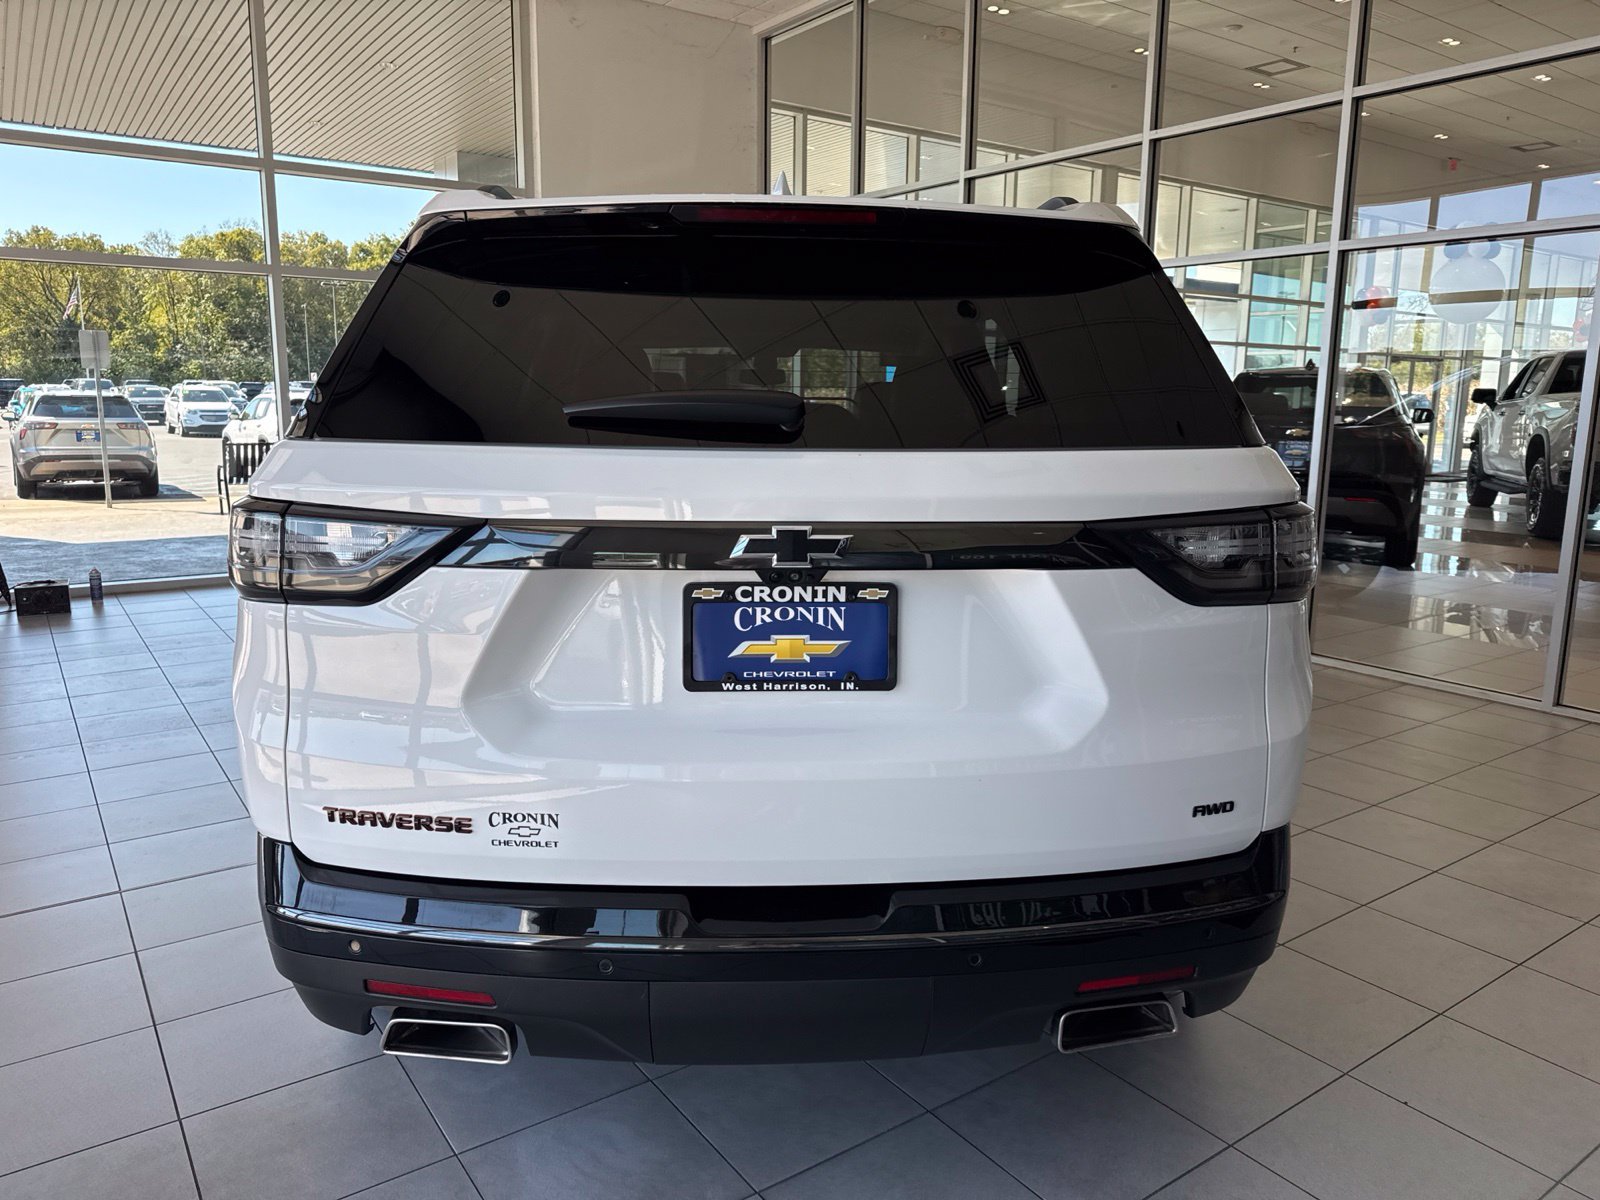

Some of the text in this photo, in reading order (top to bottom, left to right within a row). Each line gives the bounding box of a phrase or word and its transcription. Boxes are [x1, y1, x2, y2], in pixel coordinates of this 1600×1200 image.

[734, 585, 847, 603] CRONIN
[733, 606, 847, 632] CRONIN
[743, 670, 837, 678] CHEVROLET
[721, 682, 859, 692] West Harrison, IN.
[1192, 800, 1235, 818] AWD
[322, 806, 474, 834] TRAVERSE
[488, 811, 560, 830] CRONIN
[491, 839, 559, 848] CHEVROLET
